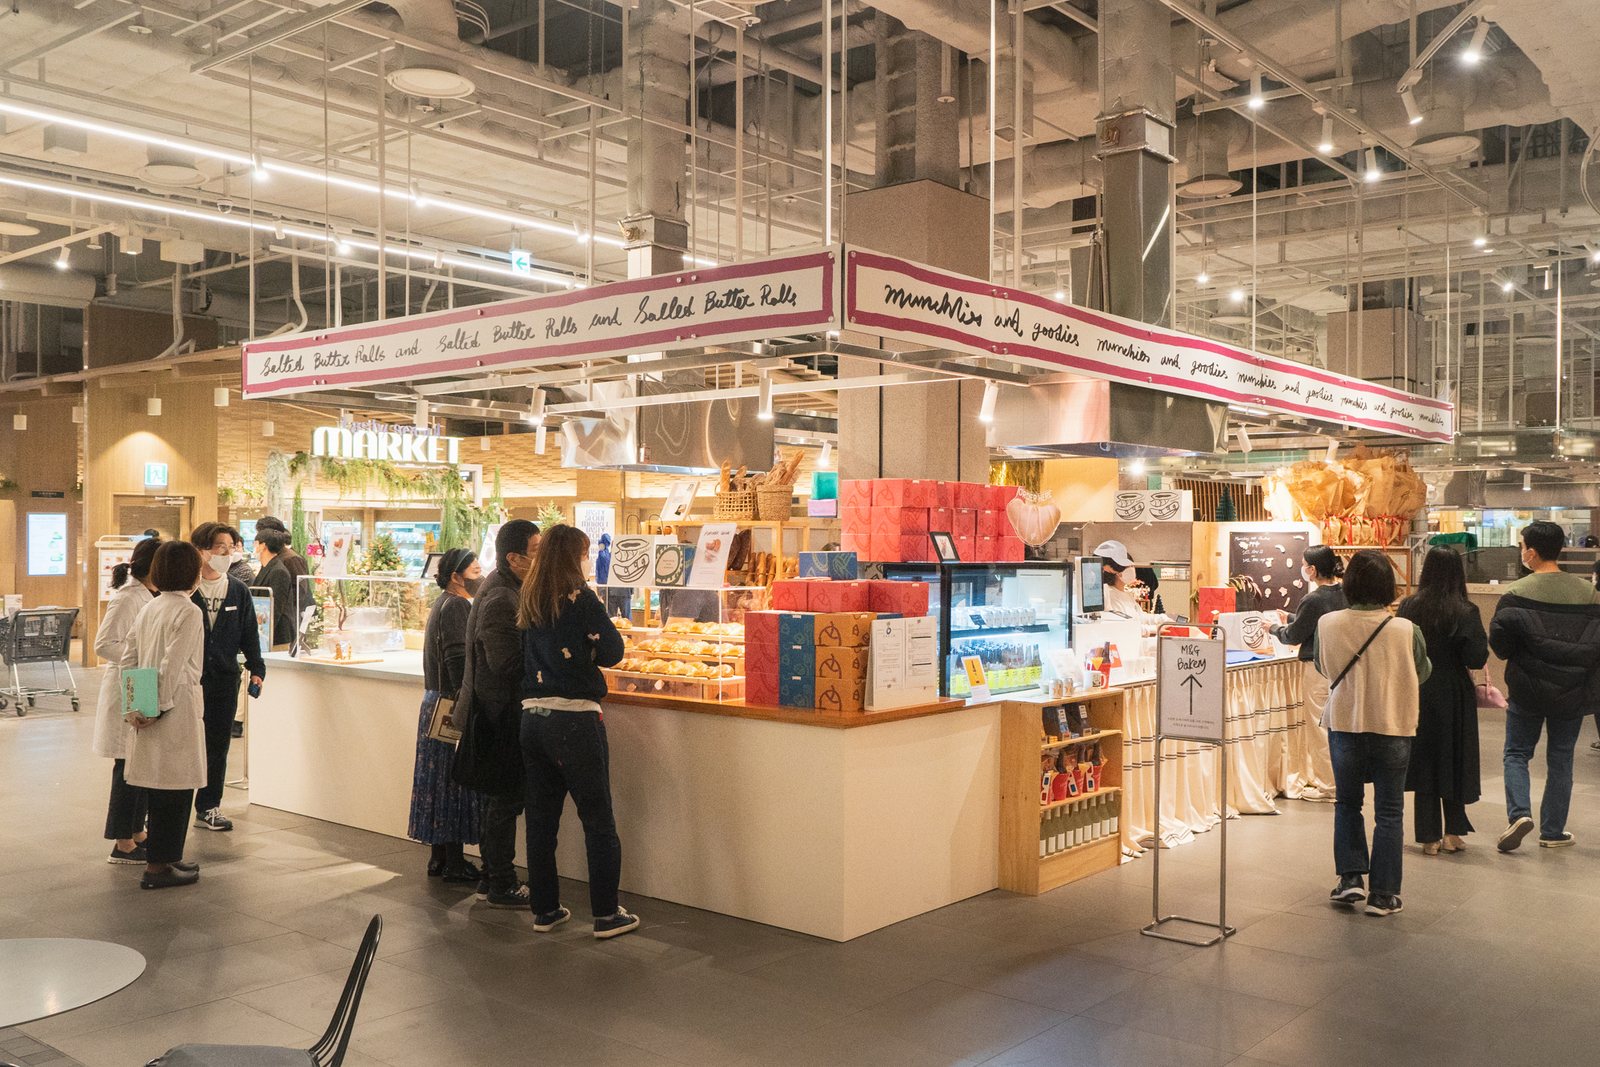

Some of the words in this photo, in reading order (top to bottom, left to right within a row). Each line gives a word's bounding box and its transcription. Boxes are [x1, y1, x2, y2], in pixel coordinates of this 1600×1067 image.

[260, 356, 304, 377] Salted
[314, 348, 350, 369] Butter
[396, 339, 422, 358] and
[436, 328, 481, 352] Salted
[493, 320, 535, 343] Butter
[588, 307, 622, 330] and
[704, 287, 755, 314] Butter
[994, 307, 1023, 337] and
[1032, 321, 1080, 347] goodies
[1161, 353, 1181, 370] and
[1190, 360, 1229, 380] goodies
[313, 426, 465, 464] MARKET
[1181, 645, 1200, 656] M&G
